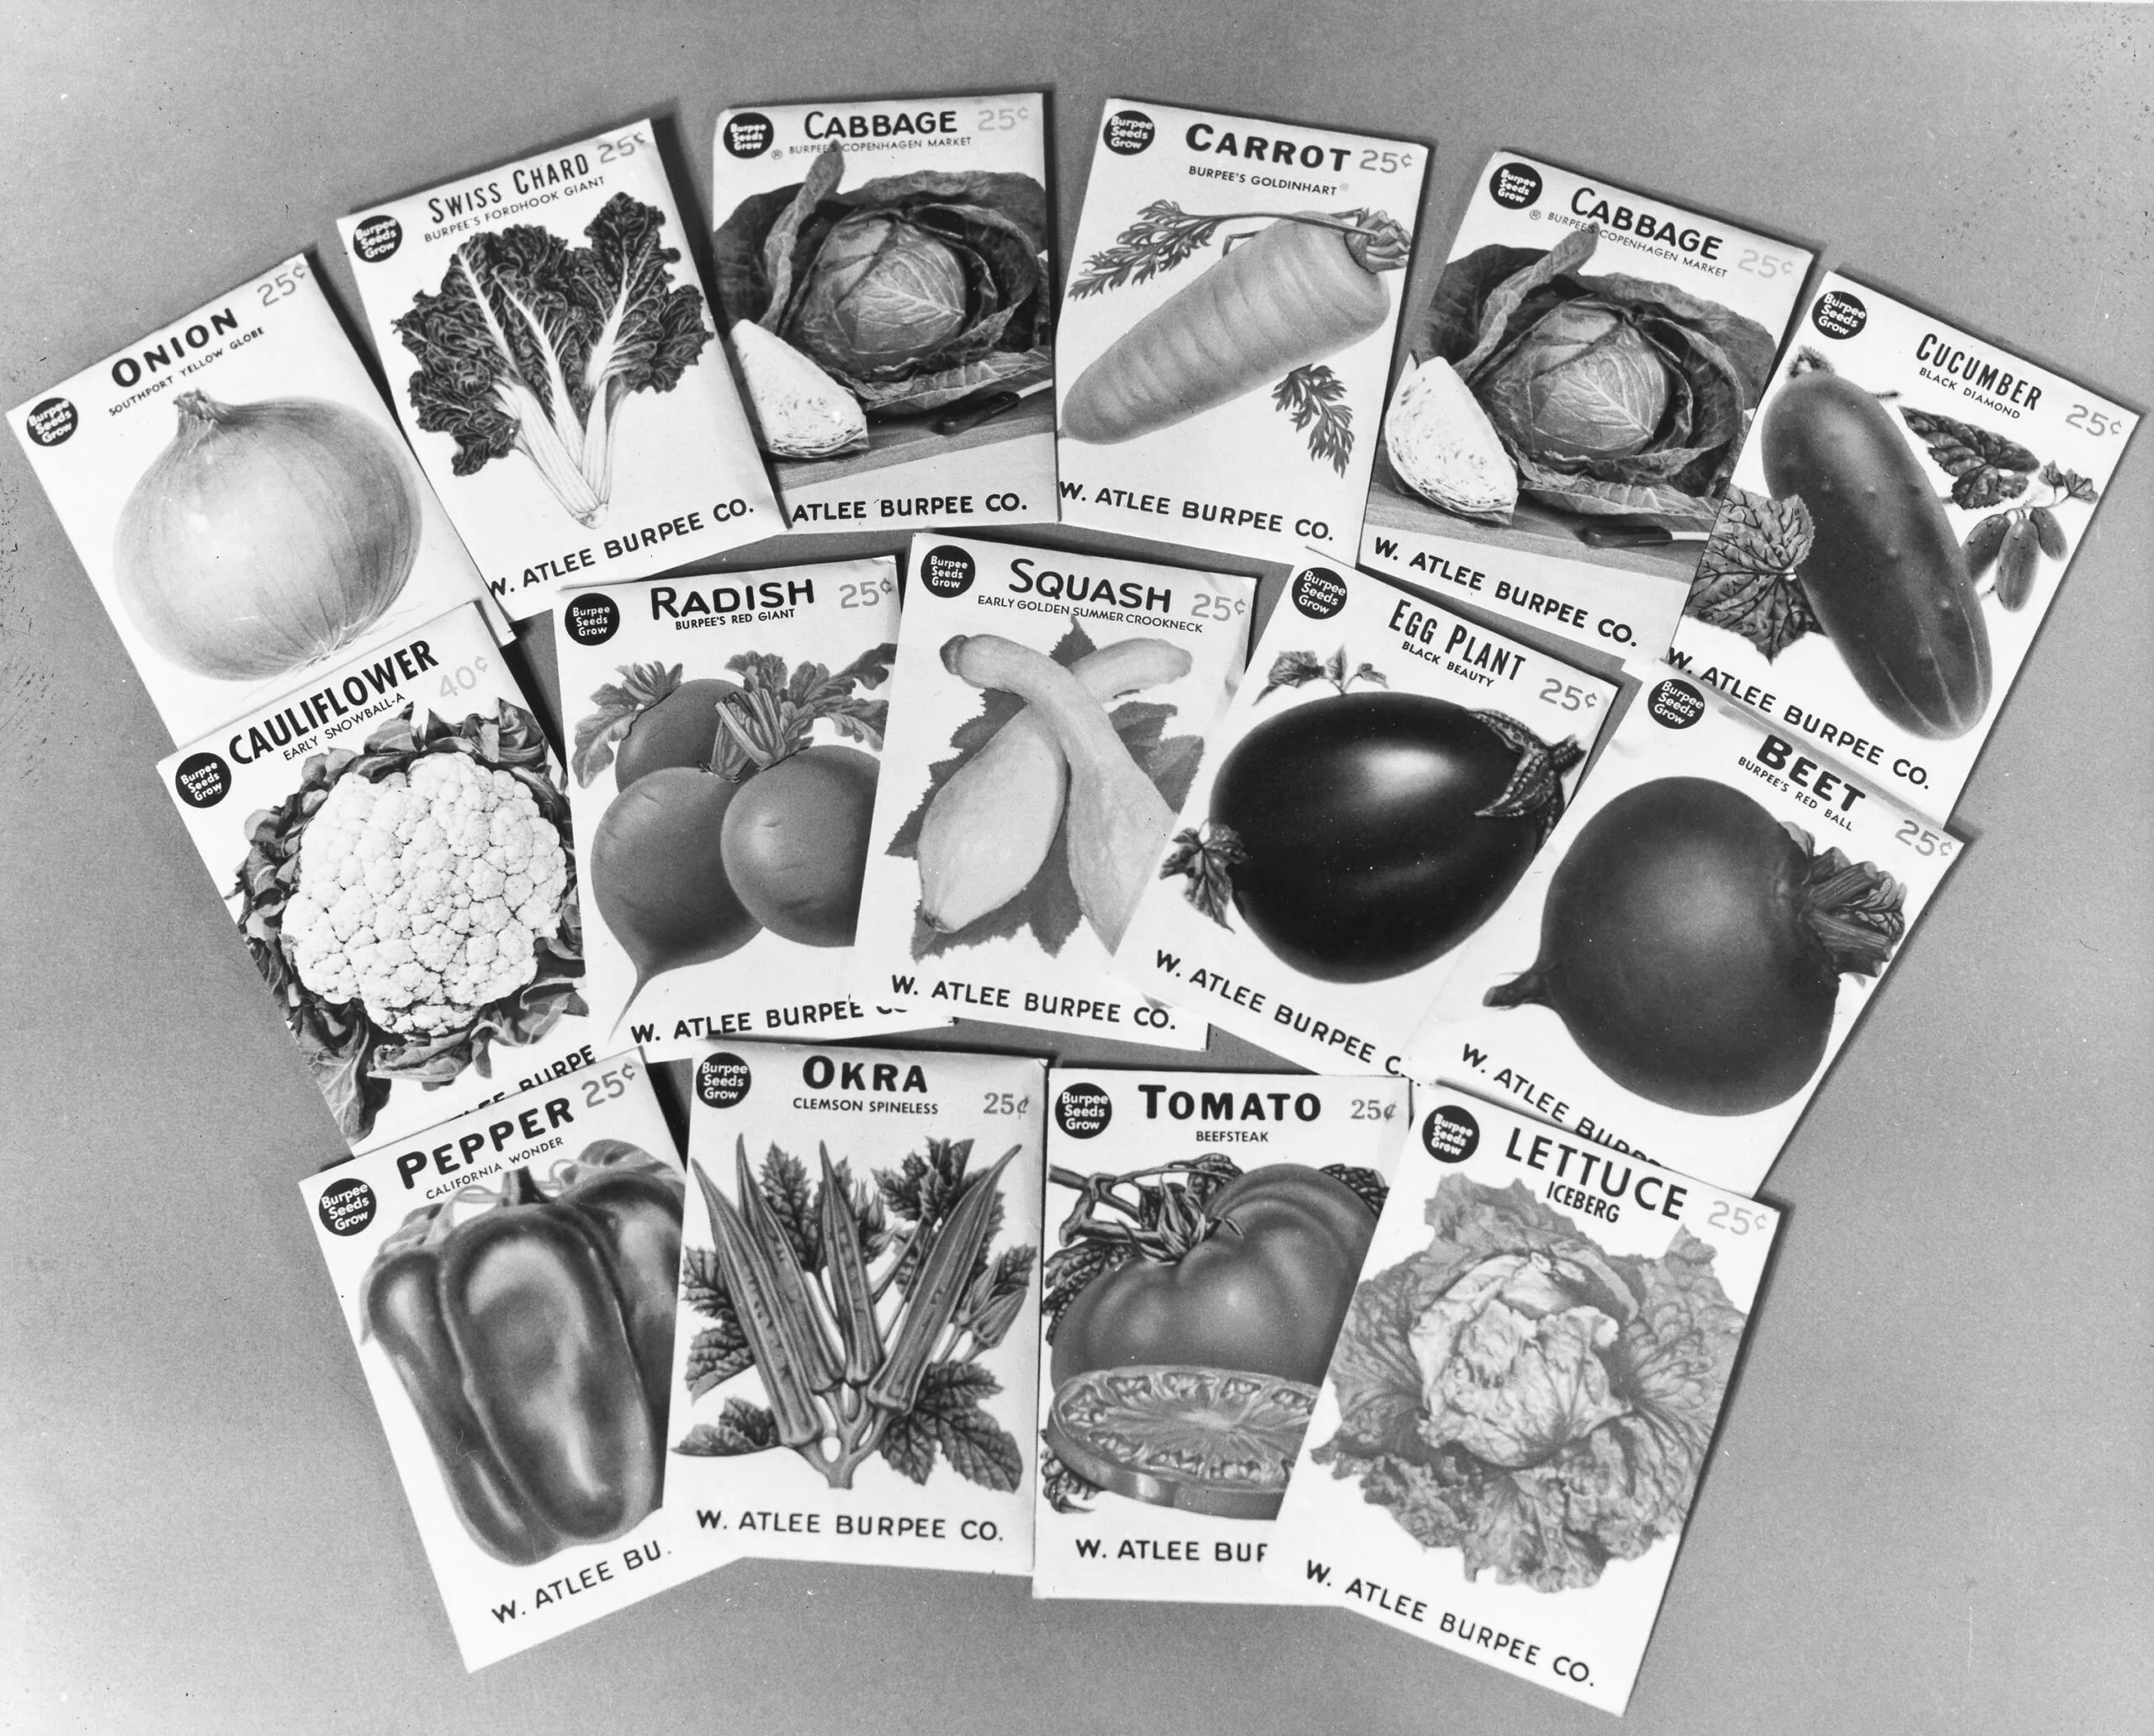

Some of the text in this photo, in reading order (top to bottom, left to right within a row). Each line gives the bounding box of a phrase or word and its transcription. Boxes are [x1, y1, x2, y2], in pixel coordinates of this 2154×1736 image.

[804, 111, 958, 140] CABBAGE
[1110, 117, 1153, 130] Burpee
[1111, 127, 1149, 141] Seeds
[841, 136, 971, 152] COPENHAGEN MARKET
[1111, 137, 1142, 150] Grow
[1186, 123, 1351, 172] CARROT
[428, 153, 589, 223] SWISS CHARD
[1188, 166, 1337, 196] BURPEE'S GOLDINHART
[1499, 178, 1531, 196] Seeds
[1501, 169, 1536, 188] Burpee
[1498, 188, 1525, 203] Grow
[424, 176, 605, 243] BURPEE'S FORDHOOK GIANT
[354, 218, 396, 241] Burpee
[1571, 187, 1723, 261] CABBAGE
[360, 229, 397, 250] Seeds
[365, 241, 395, 258] Grow
[1600, 228, 1728, 278] COPENHAGEN MARKET
[1821, 304, 1859, 328] Seeds
[1823, 293, 1866, 320] Burpee
[1817, 316, 1849, 336] Grow
[111, 307, 238, 387] ONION
[109, 326, 265, 417] SOUTHPORT YELLOW GLOBE
[1916, 333, 2042, 411] CUCUMBER
[1919, 367, 2021, 419] BLACK DIAMOND
[28, 399, 71, 427] Burpee
[34, 410, 72, 435] Seeds
[792, 493, 1027, 522] ATLEE BURPEE CO.
[1059, 480, 1334, 541] W. ATLEE BURPEE CO.
[523, 548, 596, 588] ATLEE
[603, 512, 704, 559] BURPEE
[713, 498, 754, 522] CO.
[930, 555, 968, 570] Burpee
[931, 566, 963, 579] Seeds
[931, 576, 961, 589] Grow
[1009, 558, 1171, 613] SQUASH
[1301, 581, 1339, 606] Seeds
[1303, 571, 1346, 597] Burpee
[1375, 536, 1637, 647] W. ATLEE BURPEE CO.
[572, 605, 610, 617] Burpee
[650, 579, 814, 620] RADISH
[1299, 595, 1329, 614] Grow
[576, 615, 608, 626] Seeds
[676, 609, 795, 630] BURPEE'S RED GIANT
[978, 595, 1203, 633] EARLY GOLDEN SUMMER CROOKNECK
[578, 625, 607, 637] Grow
[1388, 599, 1526, 681] EGG PLANT
[1402, 640, 1494, 687] BLACK BEAUTY
[229, 640, 439, 764] CAULIFLOWER
[1658, 692, 1695, 718] Seeds
[1661, 681, 1704, 709] Burpee
[283, 692, 406, 762] EARLY SNOWBALL-A
[1654, 703, 1685, 725] Grow
[1669, 647, 1929, 790] W. ATLEE BURPEE CO.
[180, 761, 218, 785] Burpee
[188, 773, 220, 793] Seeds
[1756, 735, 1866, 812] BEET
[194, 783, 222, 802] Grow
[1738, 757, 1852, 831] BURPEE'S RED BALL
[892, 974, 1175, 1030] W. ATLEE BURPEE CO.
[1157, 949, 1376, 1064] W. ATLEE BURPEE
[630, 1000, 863, 1043] W. ATLEE BURPEE
[702, 1062, 748, 1075] Burpee
[703, 1075, 744, 1087] Seeds
[803, 1055, 928, 1092] OKRA
[704, 1087, 739, 1101] Grow
[1462, 1043, 1569, 1123] W. ATLEE
[793, 1097, 938, 1114] CLEMSON SPINELESS
[1063, 1091, 1108, 1107] Burpee
[1064, 1105, 1105, 1118] Seeds
[1138, 1085, 1321, 1121] TOMATO
[1066, 1118, 1100, 1131] Grow
[1196, 1130, 1269, 1143] BEEFSTEAK
[1433, 1125, 1467, 1147] Seeds
[1435, 1113, 1473, 1135] Burpee
[396, 1097, 575, 1190] PEPPER
[1431, 1138, 1462, 1156] Grow
[426, 1136, 564, 1200] CALIFORNIA WONDER
[1505, 1127, 1687, 1220] LETTUCE
[321, 1183, 369, 1210] Burpee
[328, 1197, 370, 1220] Seeds
[1547, 1181, 1620, 1224] ICEBERG
[334, 1211, 369, 1232] Grow
[697, 1510, 1003, 1542] W. ATLEE BURPEE CO.
[1075, 1539, 1199, 1560] W. ATLEE
[491, 1561, 614, 1623] W. ATLEE
[1308, 1559, 1594, 1686] W. ATLEE BURPEE CO.
